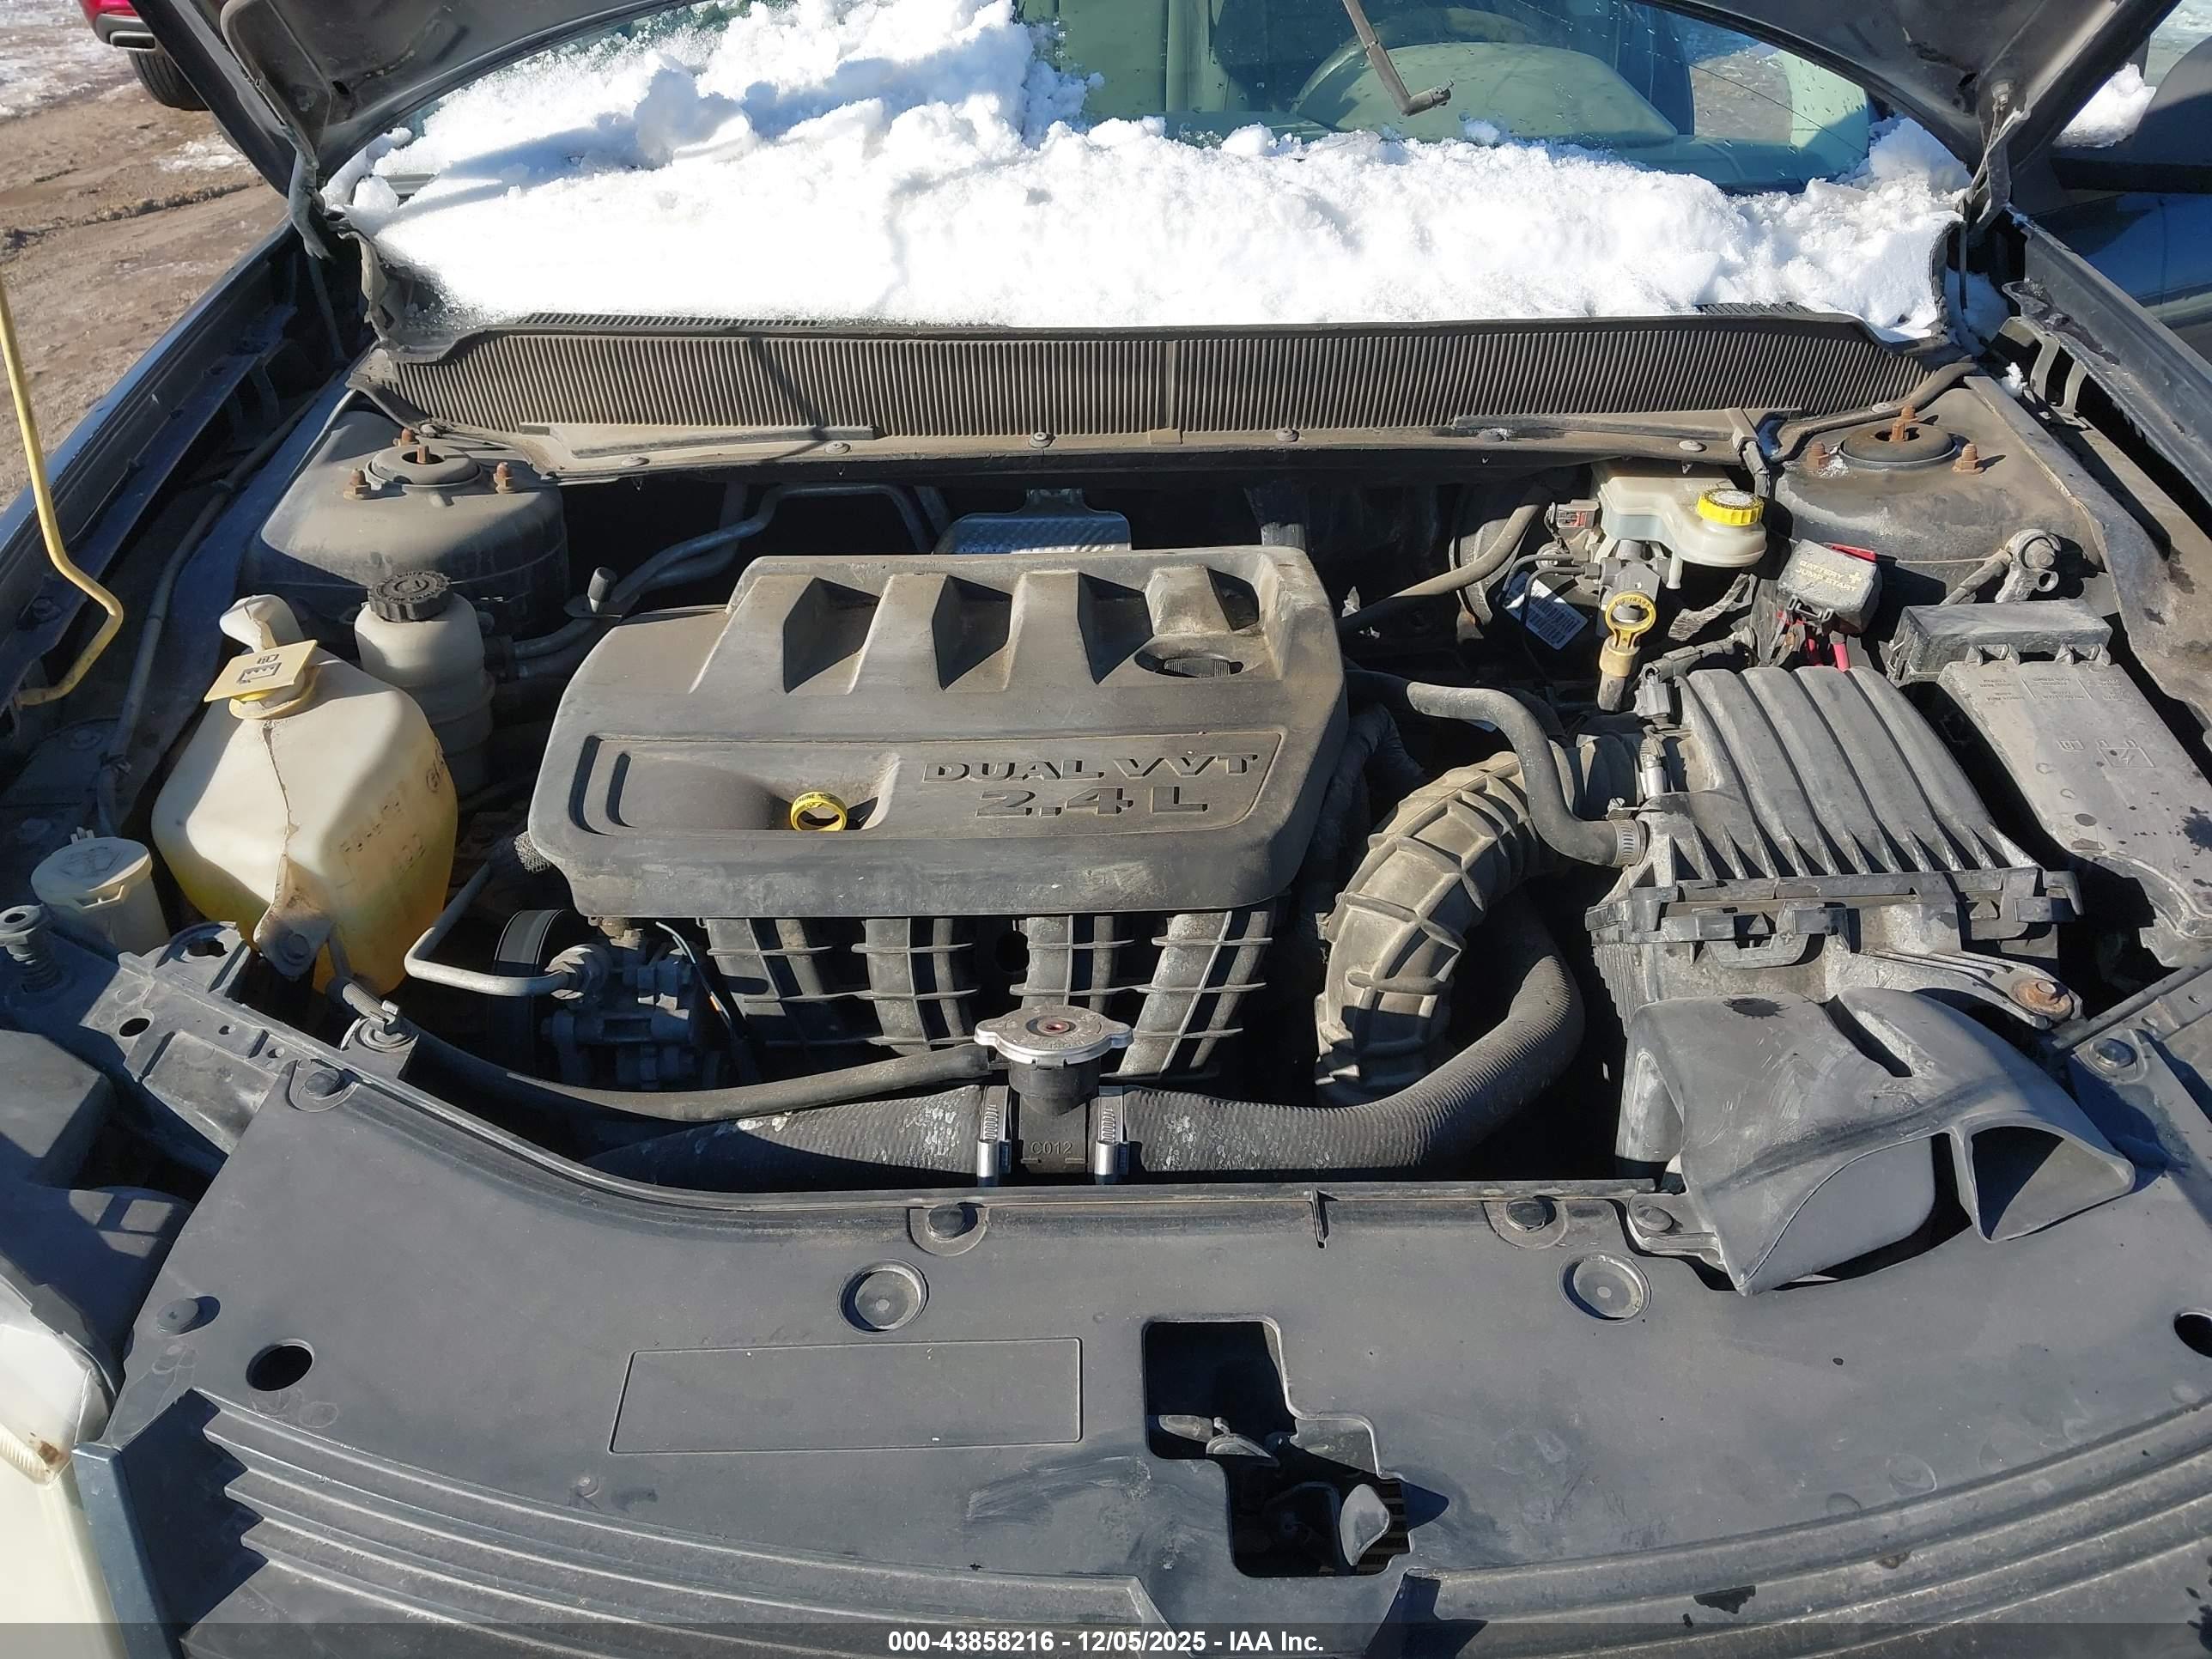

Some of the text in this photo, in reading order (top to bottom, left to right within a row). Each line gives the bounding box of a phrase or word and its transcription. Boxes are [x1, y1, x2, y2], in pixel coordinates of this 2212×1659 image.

[1796, 568, 1857, 592] JUMP START
[1799, 560, 1844, 580] BATTERY
[922, 754, 1259, 783] DUAL VVT
